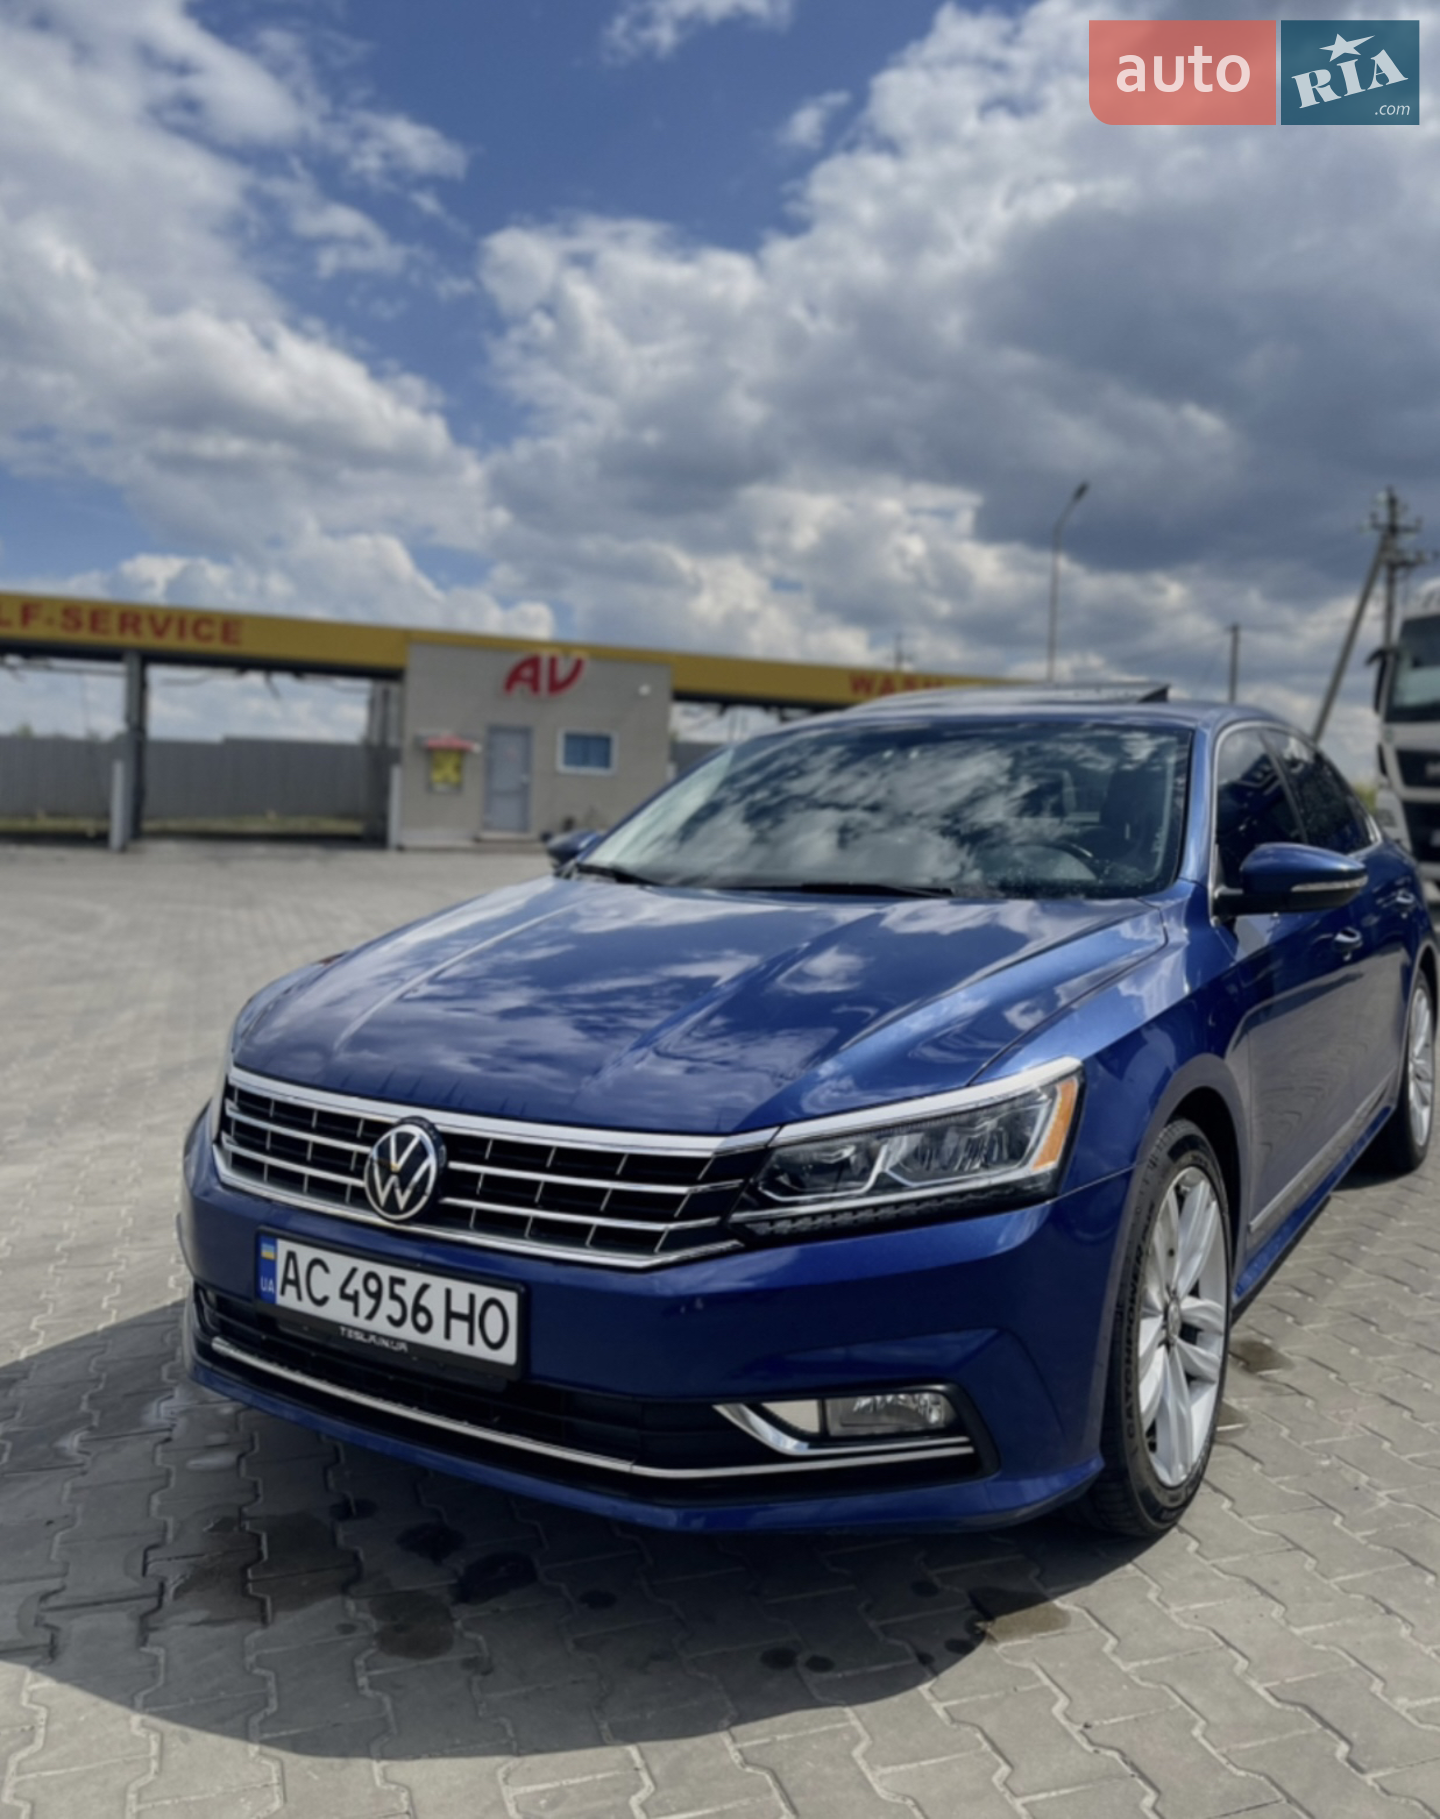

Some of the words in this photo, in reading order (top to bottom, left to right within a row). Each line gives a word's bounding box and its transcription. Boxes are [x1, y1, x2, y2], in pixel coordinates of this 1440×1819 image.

[260, 1275, 275, 1294] UA
[279, 1250, 331, 1307] AC
[338, 1266, 434, 1335] 4956
[443, 1287, 510, 1351] HO
